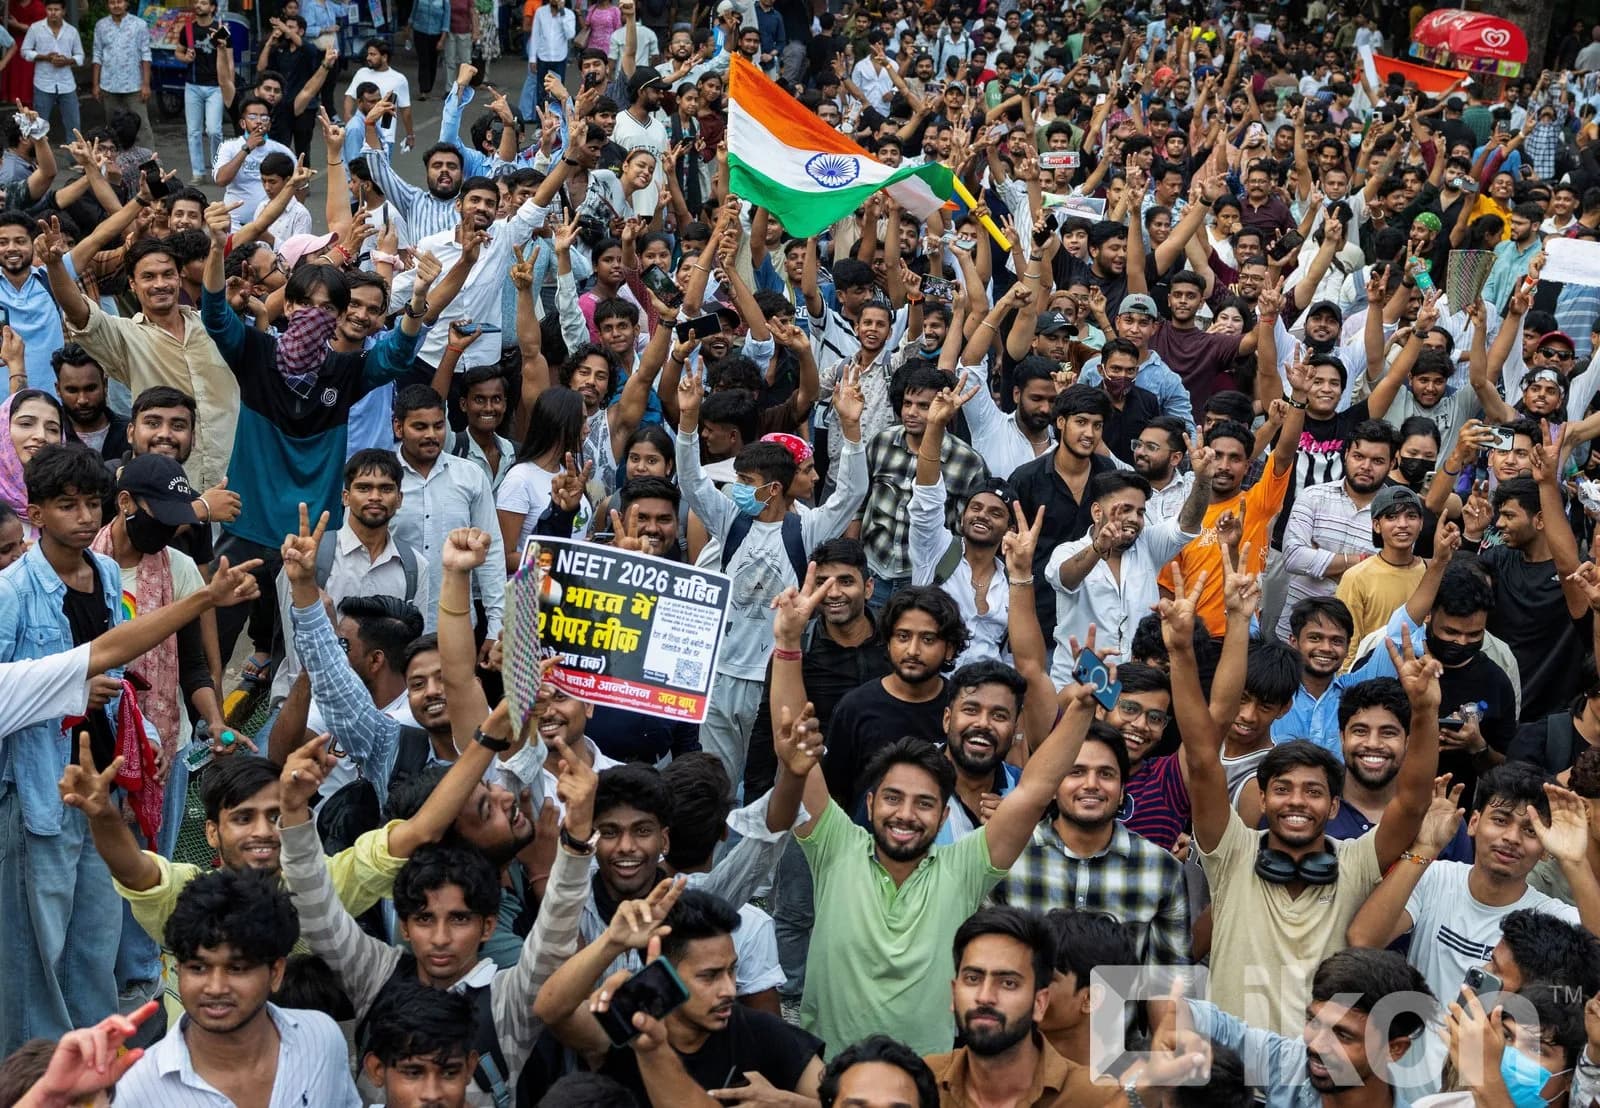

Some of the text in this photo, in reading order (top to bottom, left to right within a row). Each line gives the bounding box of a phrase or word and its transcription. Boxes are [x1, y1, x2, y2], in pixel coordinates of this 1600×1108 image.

[556, 549, 669, 593] NEET 2026
[566, 586, 627, 615] भारत
[631, 592, 657, 620] में
[673, 574, 722, 605] सहित
[551, 606, 591, 646] पेपर
[592, 617, 641, 653] लीक
[580, 655, 606, 674] तक)
[566, 675, 596, 689] बचाओ
[598, 681, 651, 699] आन्दोलन
[658, 692, 677, 706] जय
[678, 695, 697, 713] बापू
